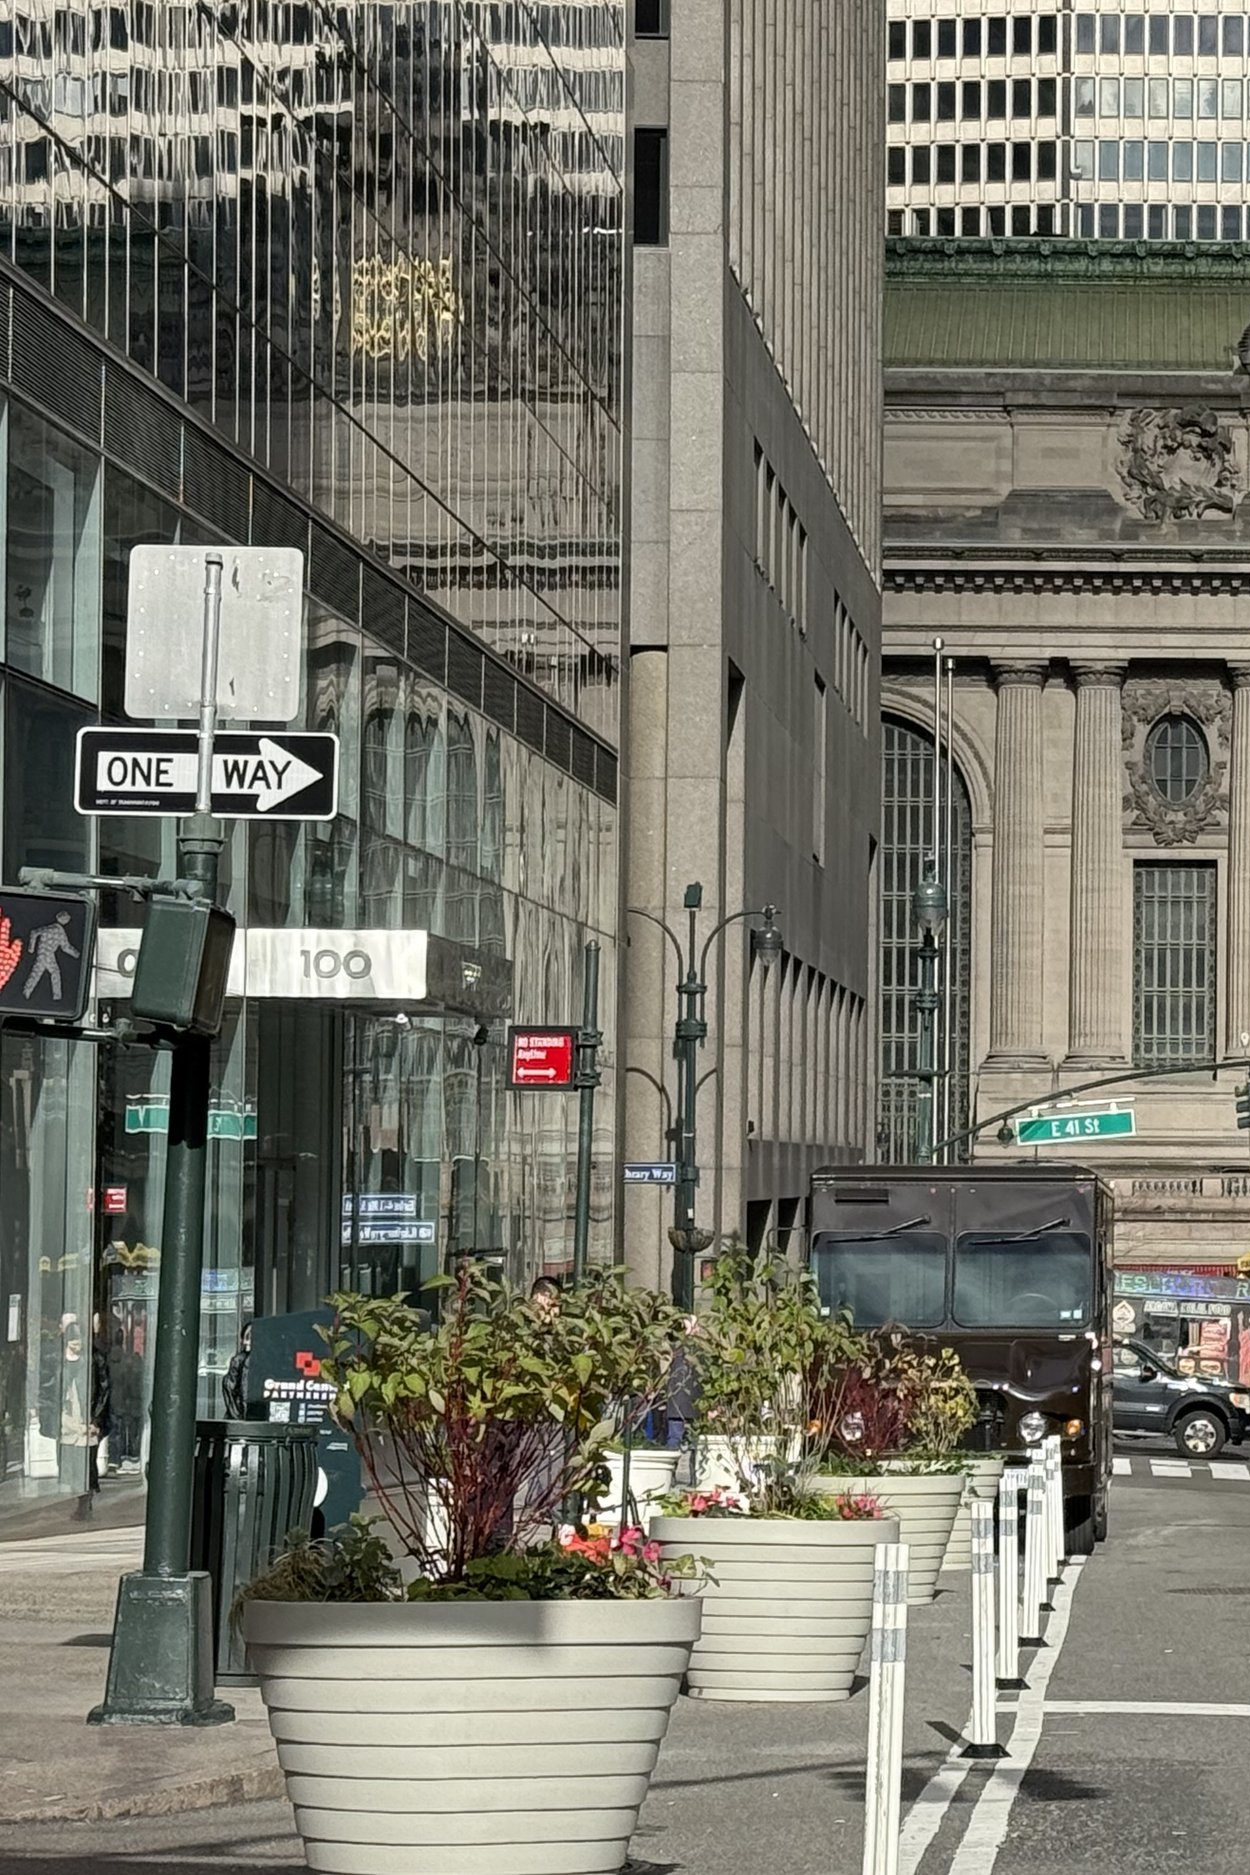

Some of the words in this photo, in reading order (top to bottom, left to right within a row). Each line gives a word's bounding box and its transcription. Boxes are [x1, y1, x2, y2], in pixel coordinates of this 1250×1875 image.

[107, 756, 174, 788] ONE
[222, 759, 292, 790] WAY
[300, 949, 372, 979] 100
[1051, 1121, 1061, 1137] E
[1065, 1119, 1079, 1135] 41
[1084, 1118, 1100, 1133] St
[624, 1168, 650, 1181] brary
[651, 1168, 673, 1181] Way
[264, 1378, 305, 1391] Grand
